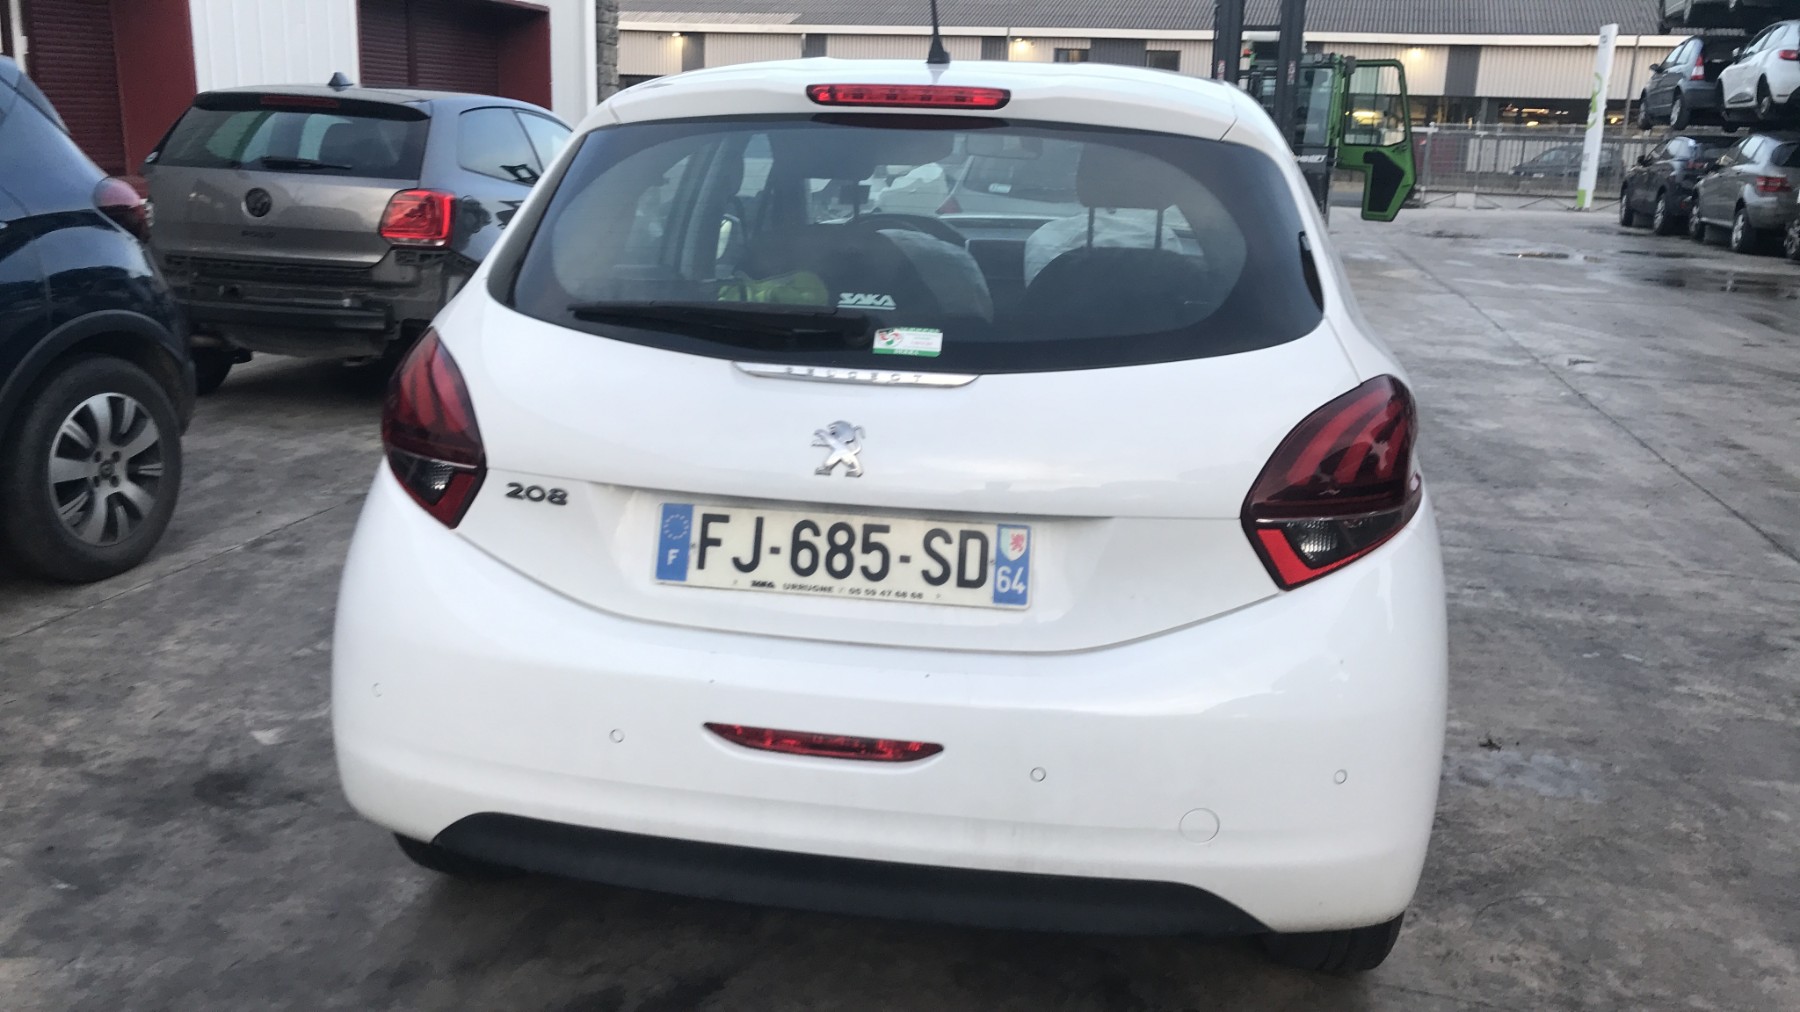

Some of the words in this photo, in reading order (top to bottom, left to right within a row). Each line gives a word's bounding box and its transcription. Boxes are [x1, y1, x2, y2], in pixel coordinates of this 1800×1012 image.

[838, 292, 897, 309] SAKA
[505, 481, 569, 506] 208
[666, 548, 680, 567] F
[697, 512, 990, 590] FJ-685-SD
[996, 566, 1026, 595] 64
